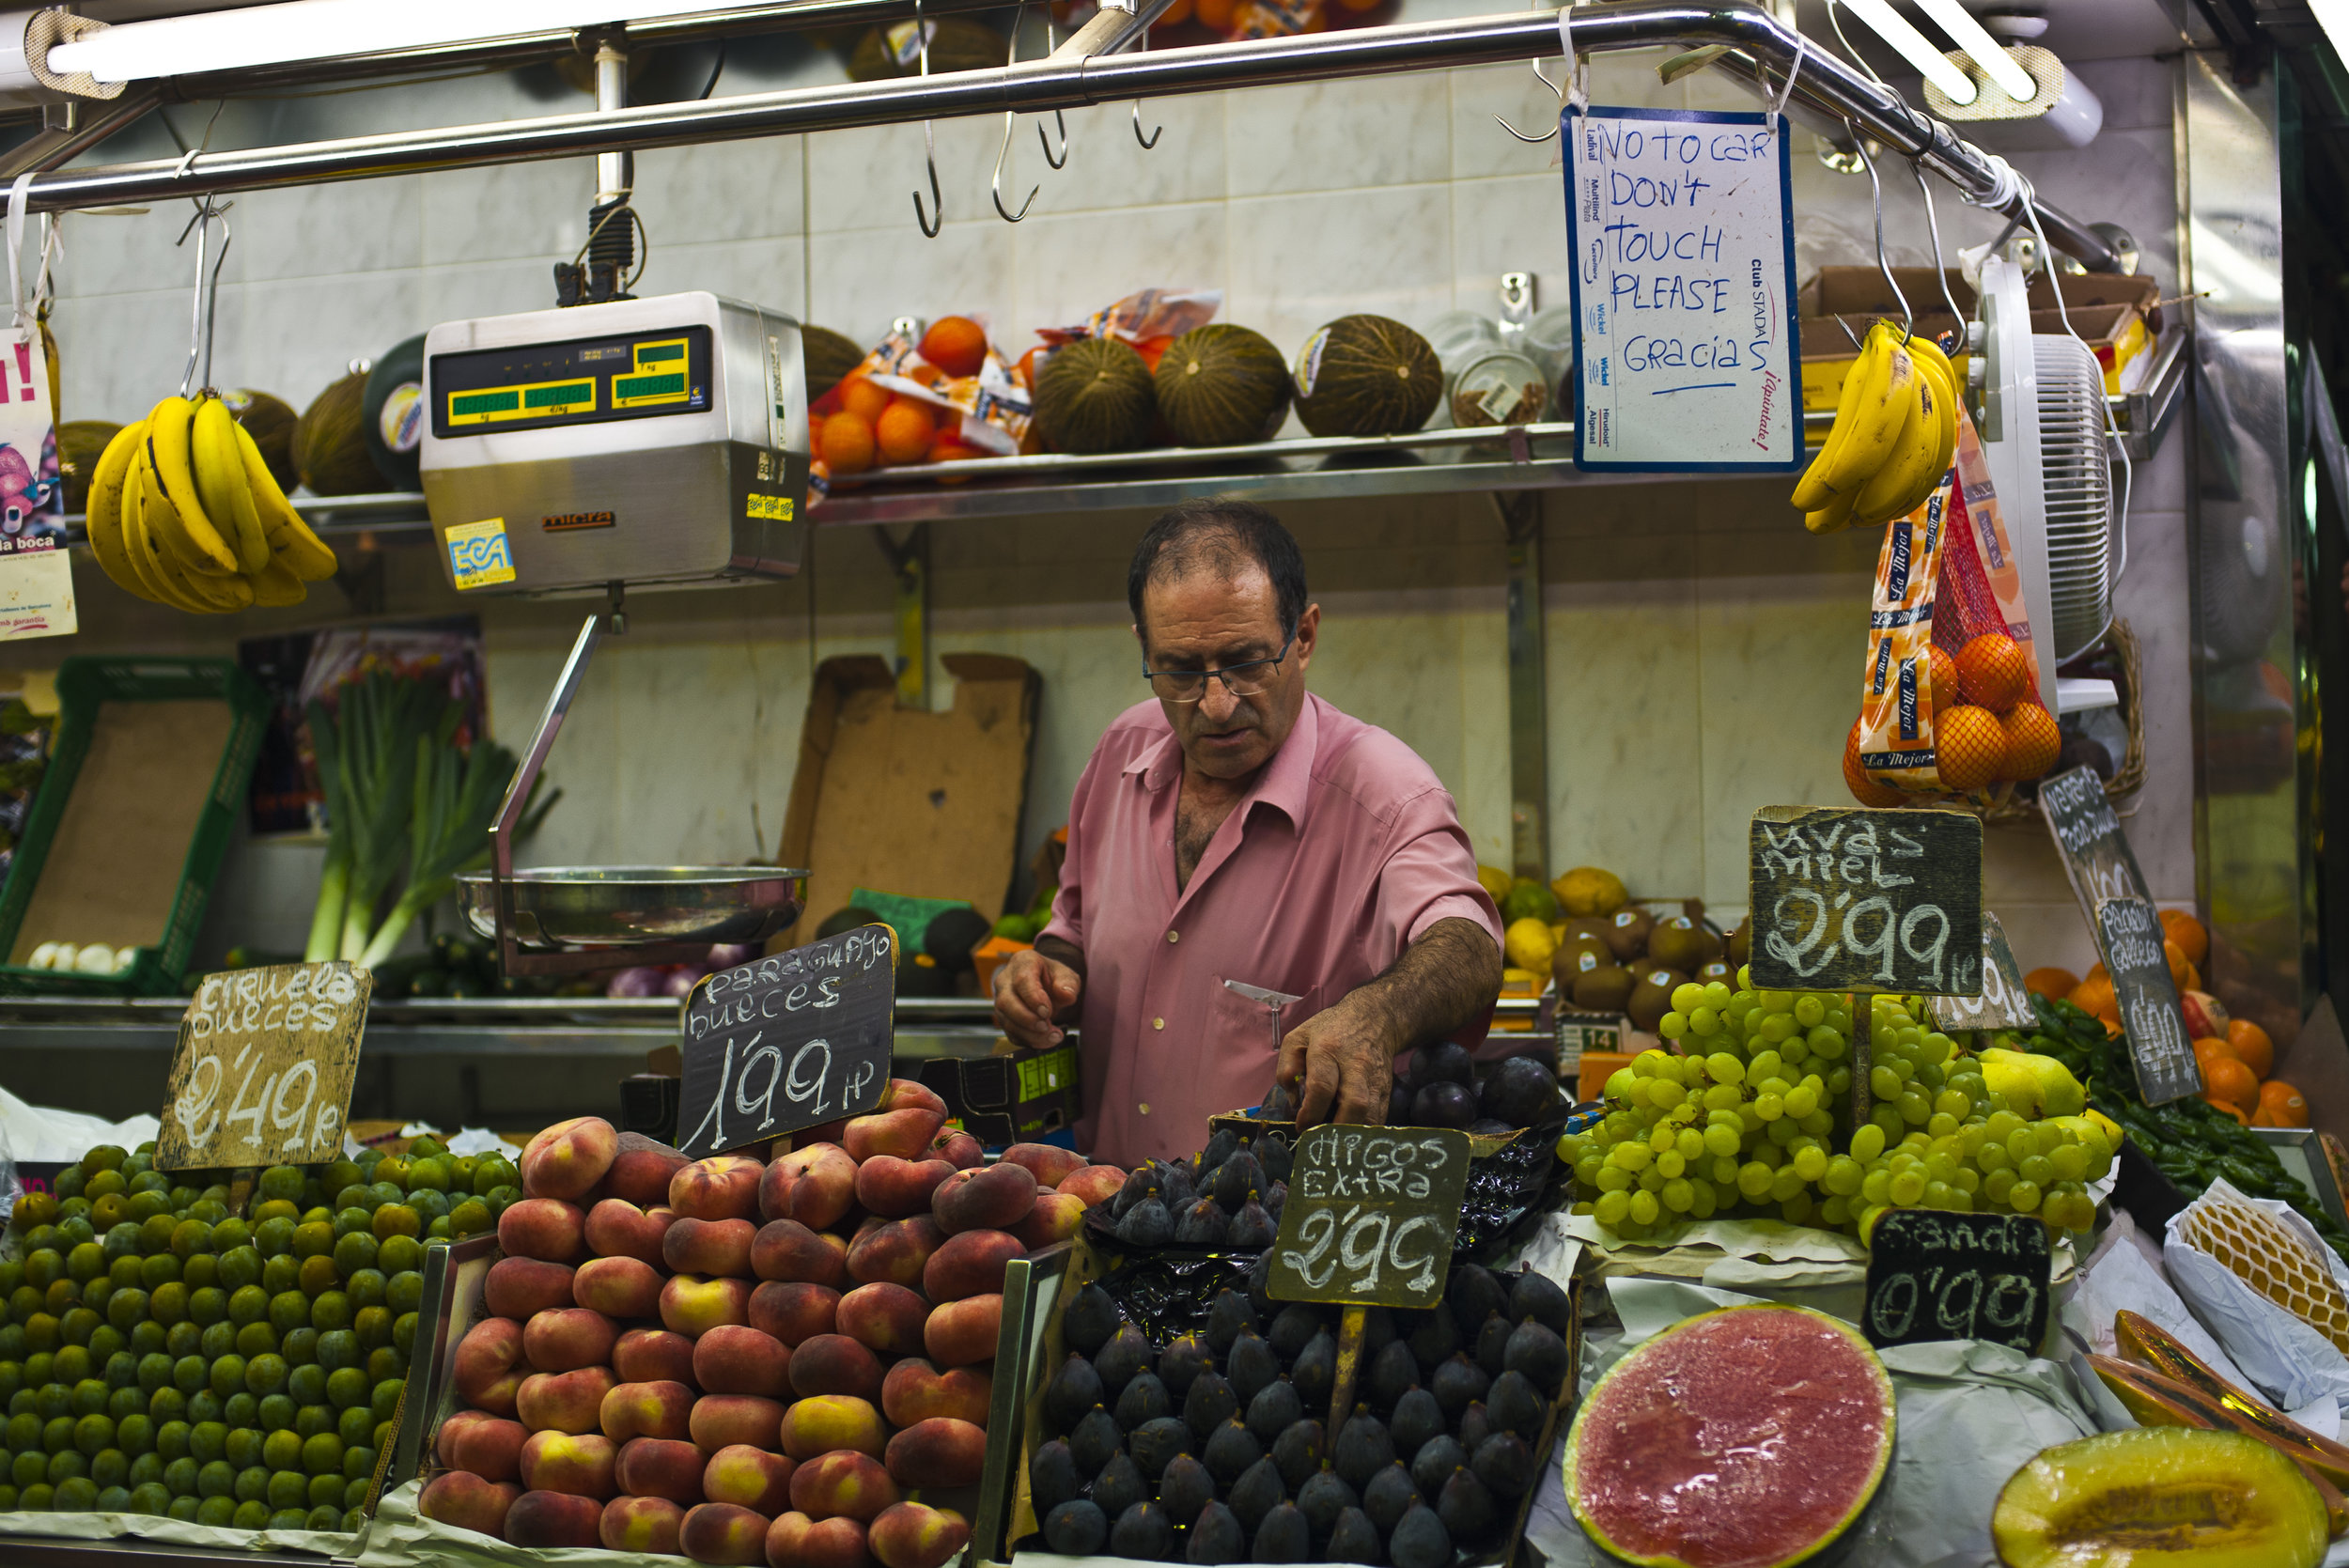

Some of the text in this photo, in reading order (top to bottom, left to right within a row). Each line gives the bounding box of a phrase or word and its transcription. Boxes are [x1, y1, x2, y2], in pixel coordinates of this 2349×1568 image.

[1586, 129, 1598, 161] Ladival
[1605, 215, 1721, 263] TOUCH
[1610, 270, 1731, 314] PLEASE
[1751, 258, 1766, 339] Club STADA
[1597, 303, 1607, 335] Wickel
[1600, 356, 1610, 387] Wickel
[1588, 410, 1597, 444] Algesal
[1890, 530, 1910, 601] La Mejor
[1875, 644, 1890, 693] La Mejor
[1900, 659, 1916, 731] La Mejor
[1863, 753, 1927, 768] La Mejor
[1588, 1029, 1610, 1048] 14
